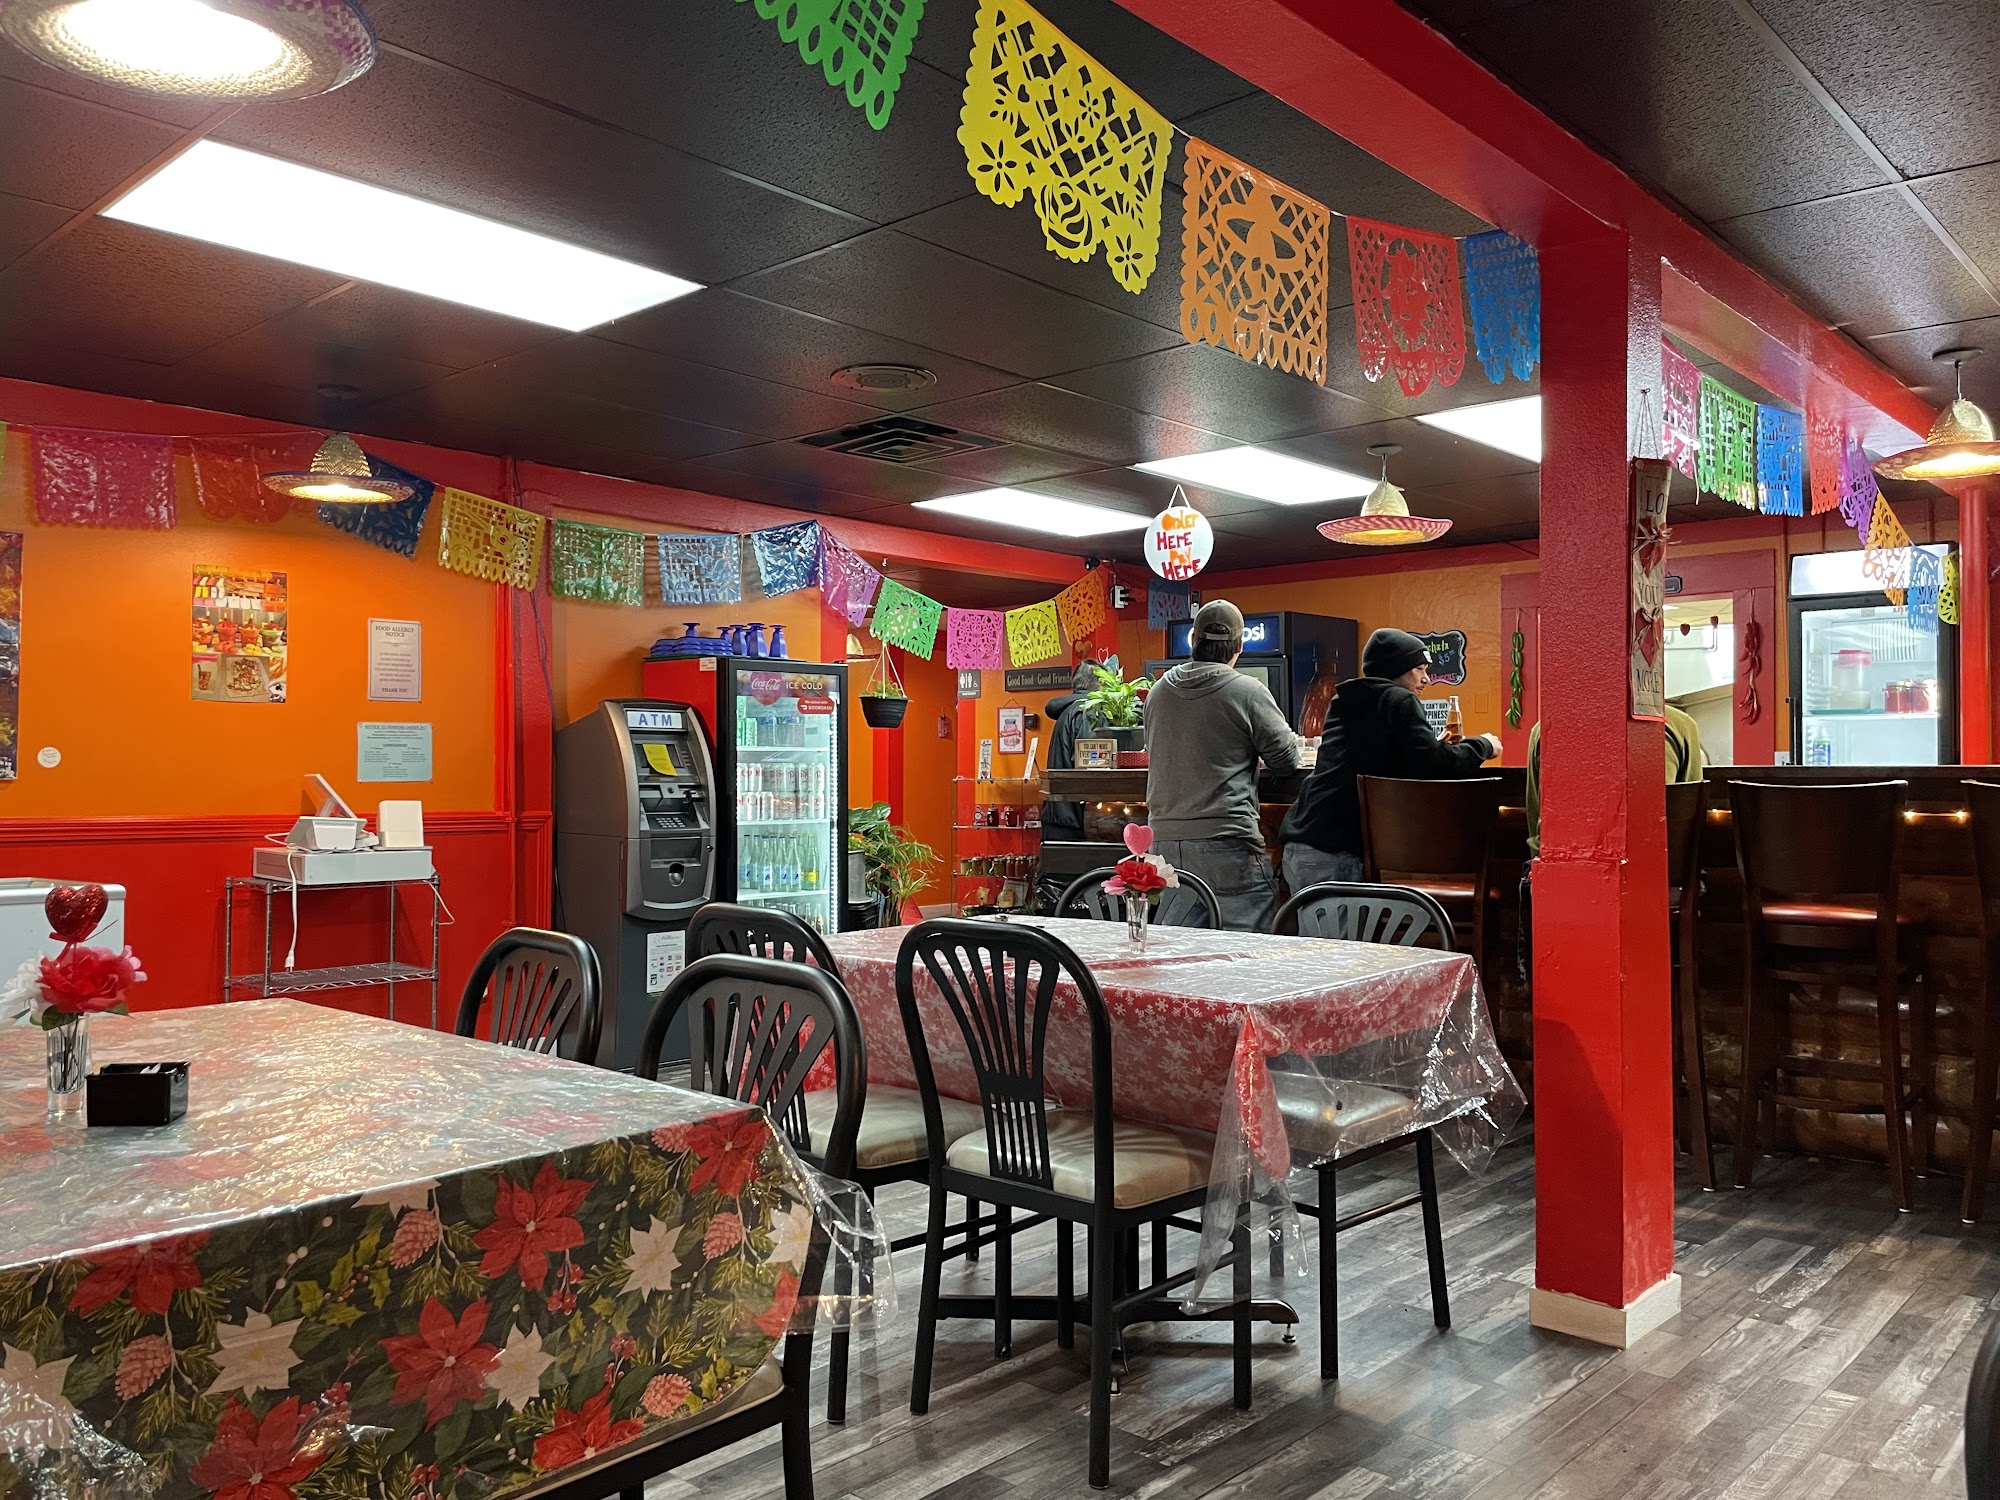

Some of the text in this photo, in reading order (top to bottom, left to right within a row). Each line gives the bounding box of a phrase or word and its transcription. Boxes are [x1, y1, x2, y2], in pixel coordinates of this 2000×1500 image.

[1637, 581, 1659, 606] YOU
[1427, 639, 1450, 654] chata
[801, 682, 823, 690] COLD
[1007, 674, 1020, 686] Good
[1021, 674, 1034, 685] Food
[1037, 673, 1051, 684] Good
[1636, 668, 1660, 693] MORE
[638, 713, 673, 726] ATM
